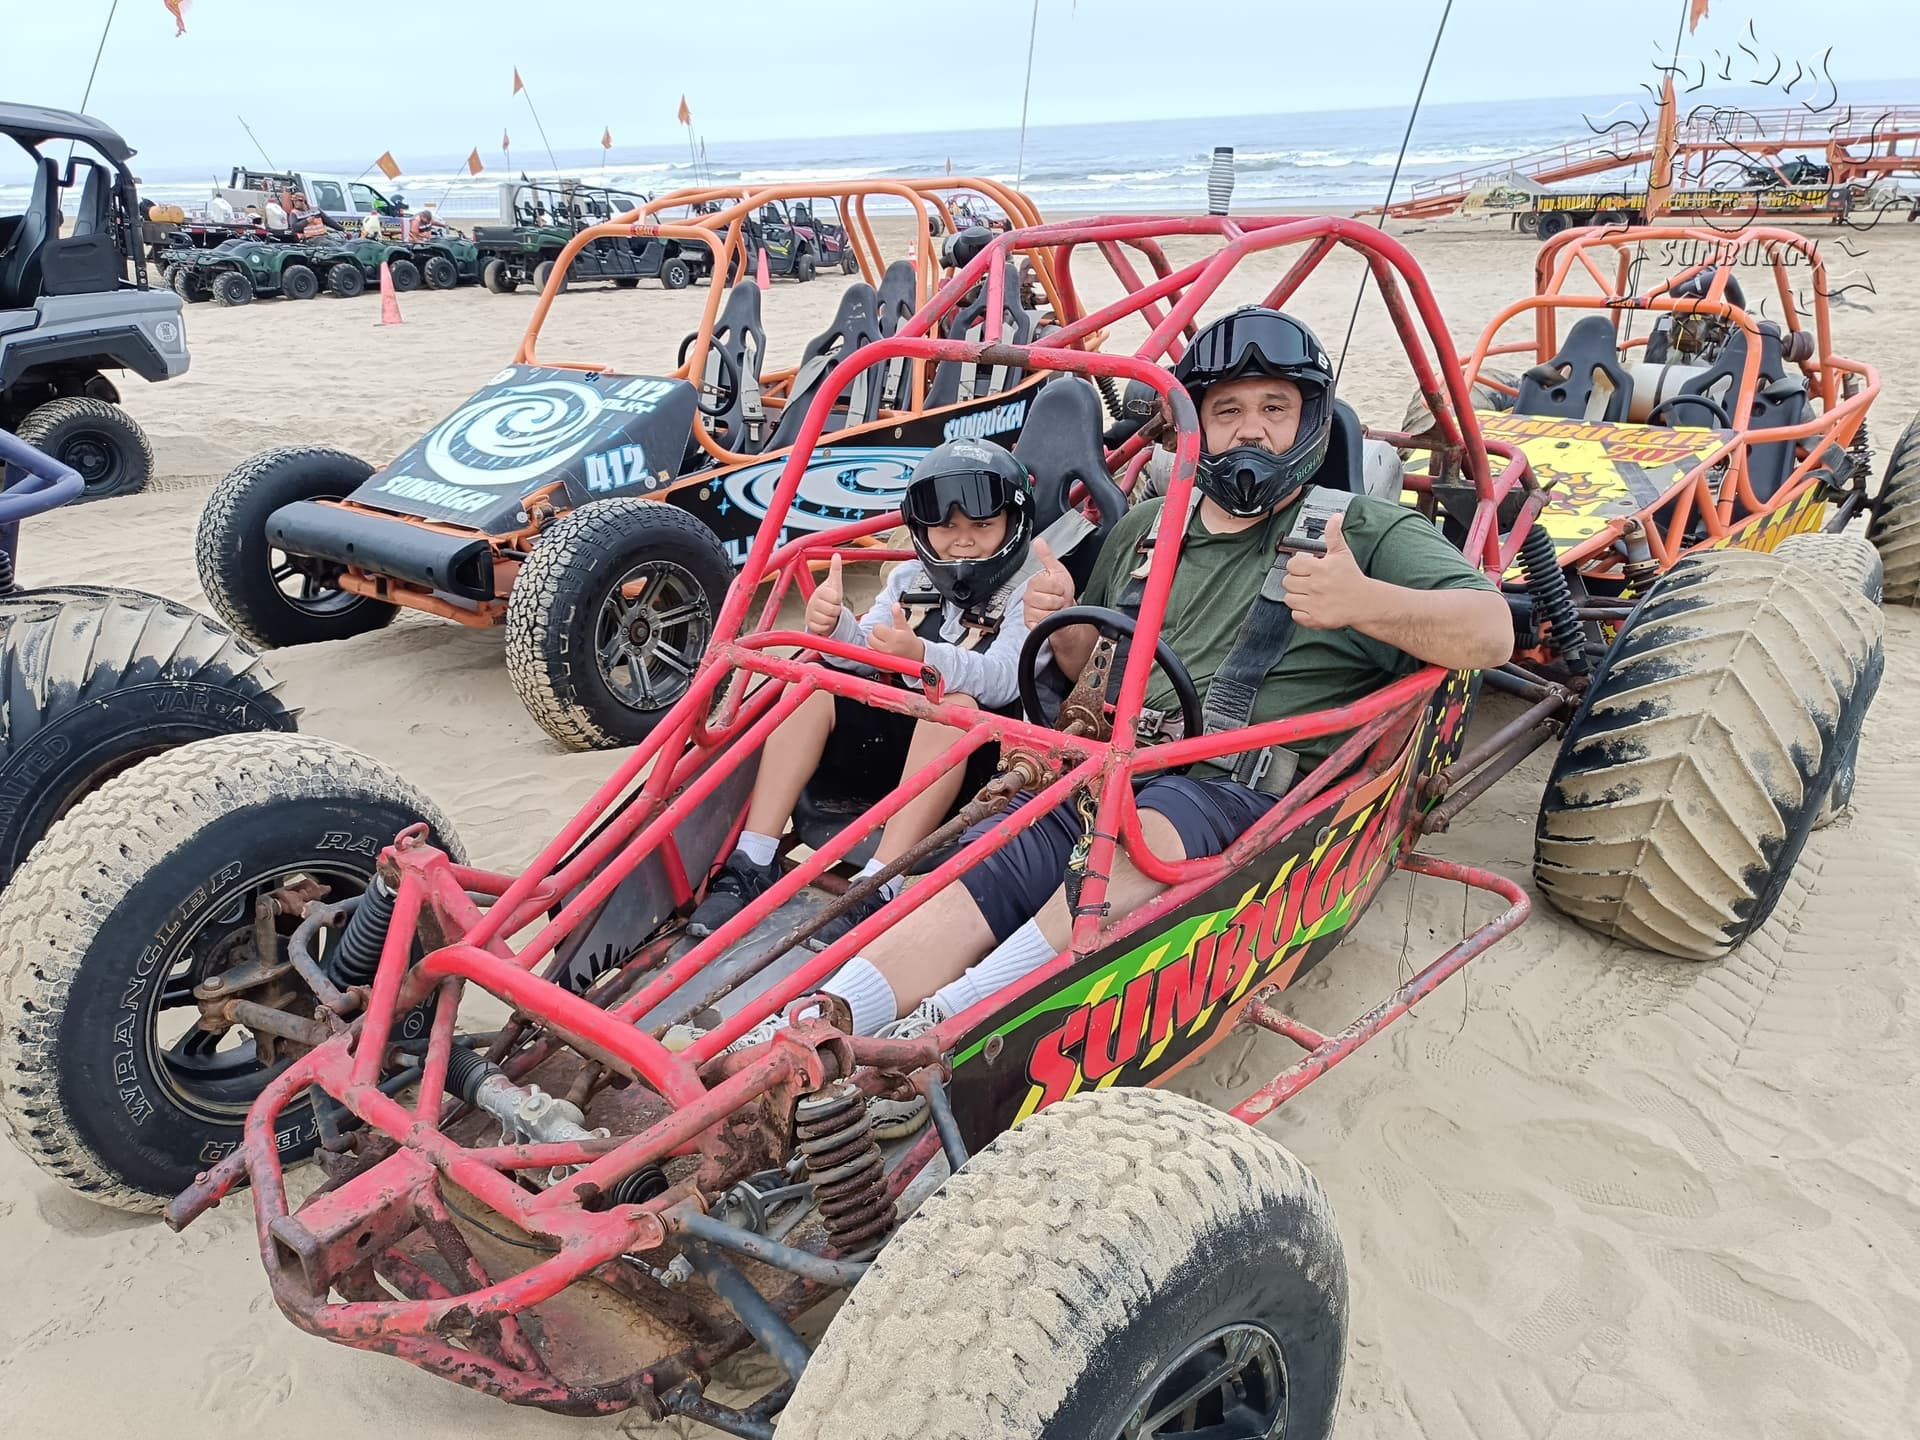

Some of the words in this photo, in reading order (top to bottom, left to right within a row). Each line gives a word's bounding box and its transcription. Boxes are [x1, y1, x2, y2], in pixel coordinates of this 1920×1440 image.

[614, 379, 676, 403] 412
[943, 399, 1027, 441] SUNBUGGY
[584, 443, 650, 492] 412
[373, 475, 503, 513] SUNBUGGY
[112, 860, 244, 1126] WRANGLER
